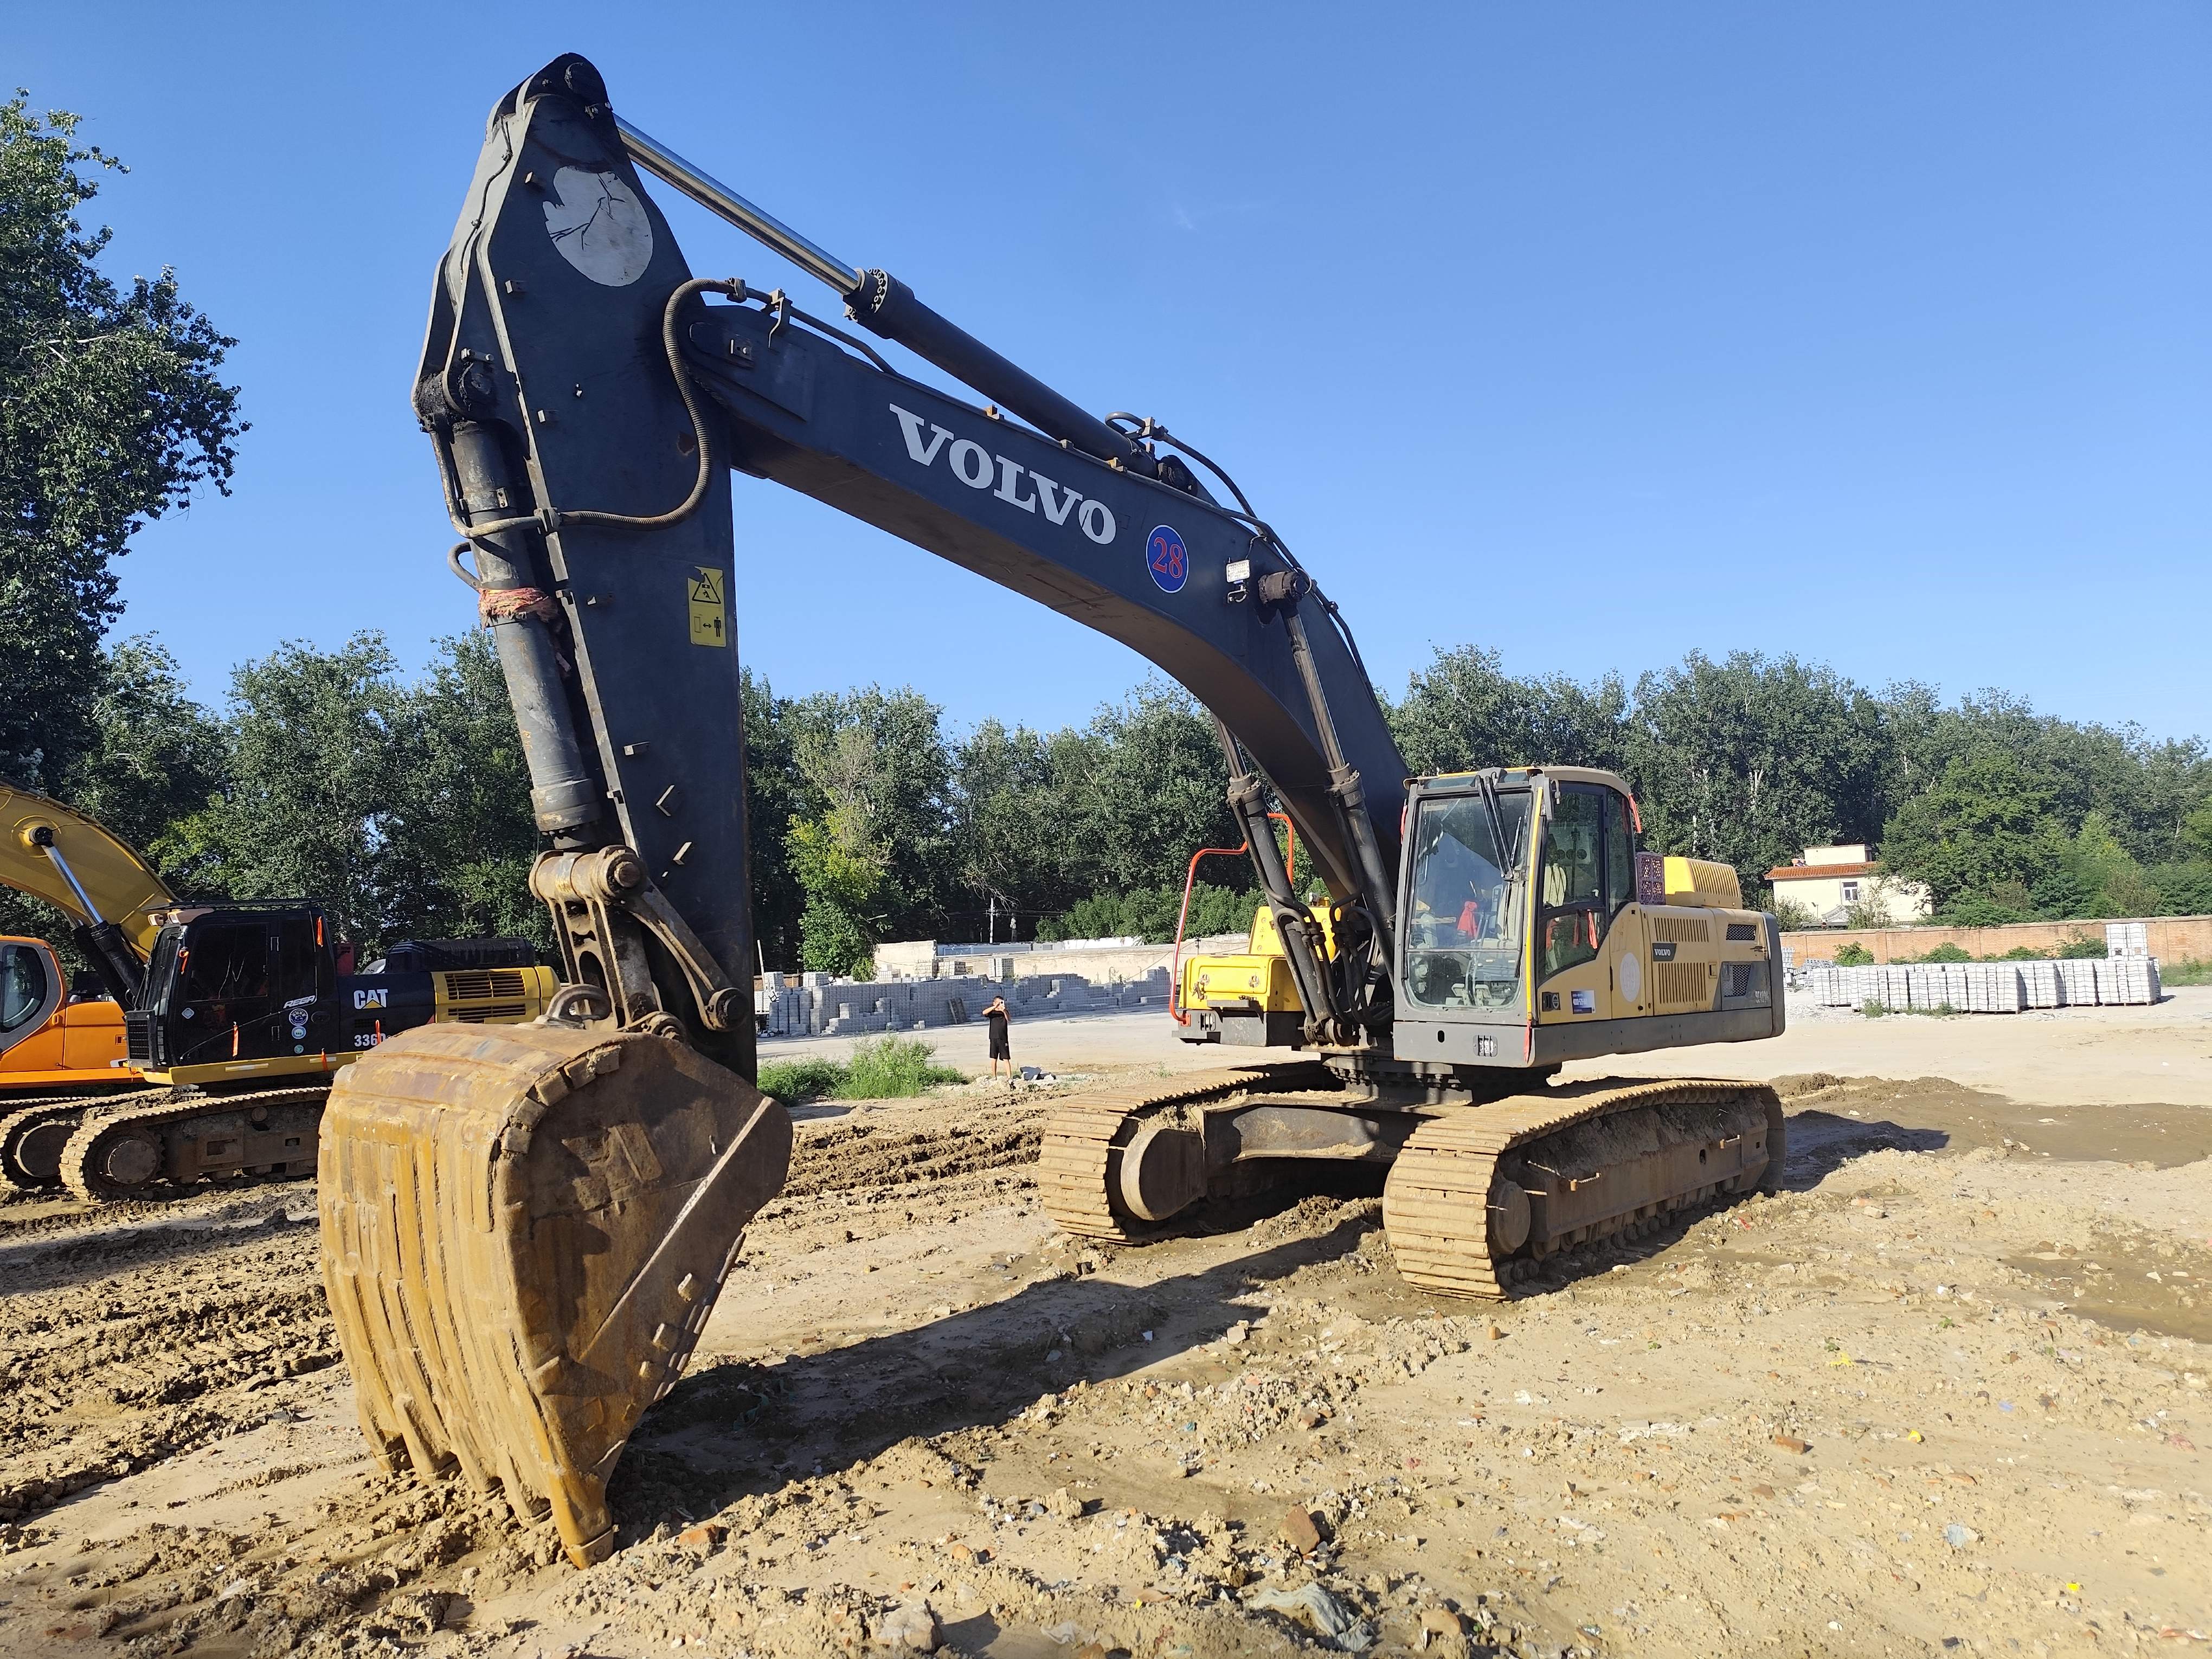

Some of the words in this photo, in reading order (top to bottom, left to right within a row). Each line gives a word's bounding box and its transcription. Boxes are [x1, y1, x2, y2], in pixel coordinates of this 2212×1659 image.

[889, 403, 1116, 544] VOLVO
[1152, 537, 1183, 578] 28
[353, 989, 388, 1009] CAT
